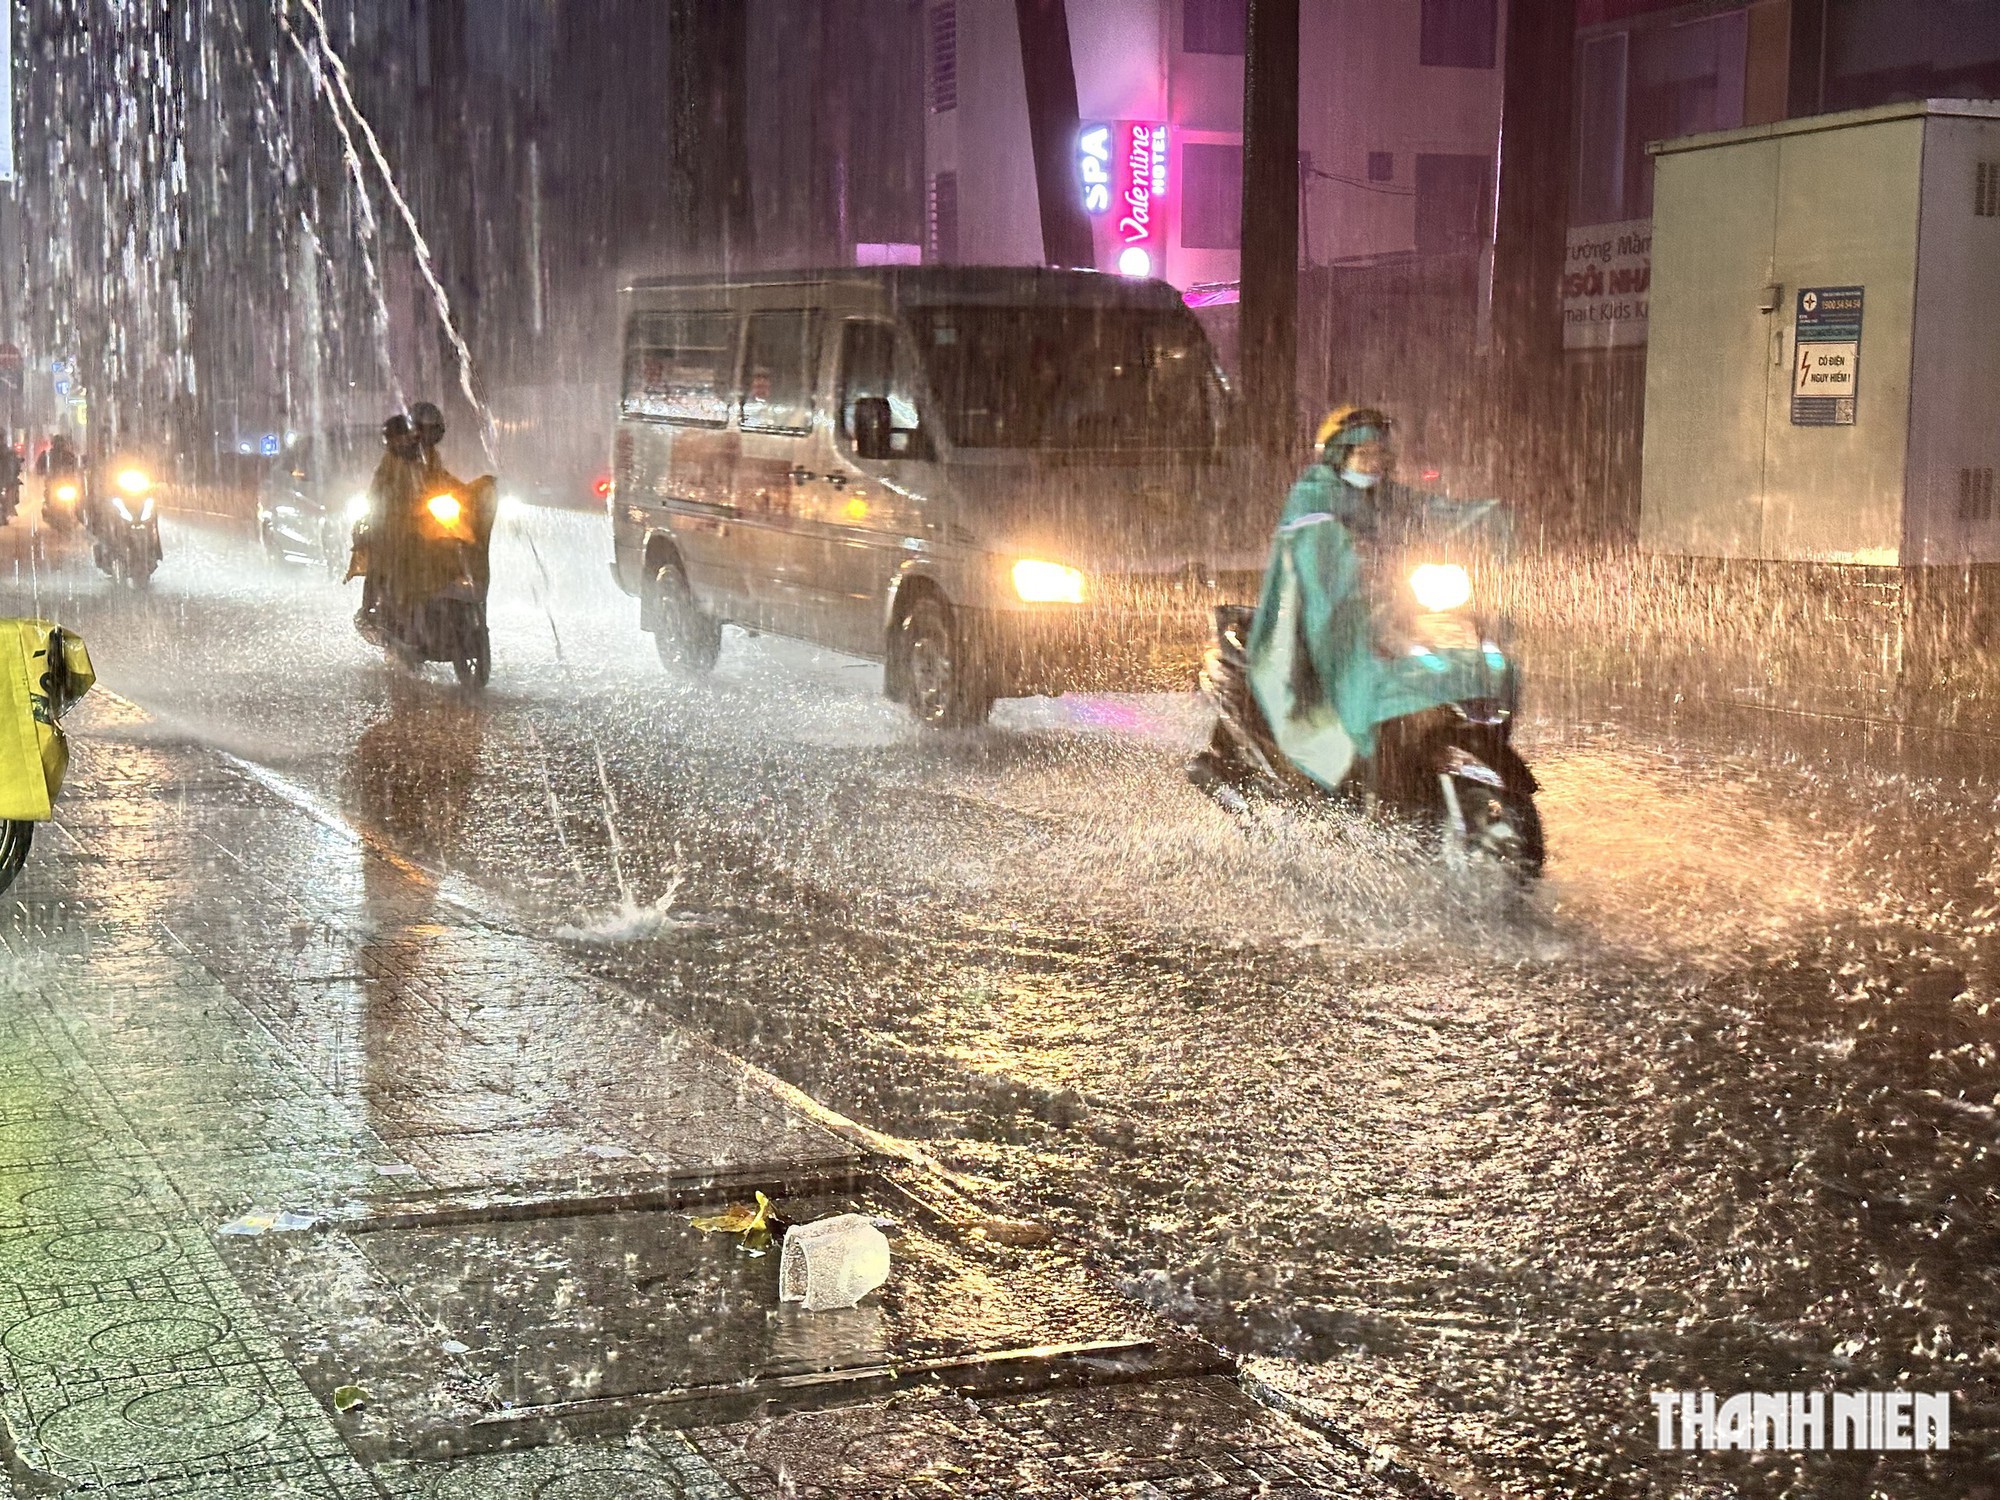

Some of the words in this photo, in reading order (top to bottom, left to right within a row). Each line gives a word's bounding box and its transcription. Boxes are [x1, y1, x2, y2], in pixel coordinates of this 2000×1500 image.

[1081, 127, 1109, 211] SPA
[1119, 125, 1151, 243] Valentine
[1151, 126, 1166, 195] HOTEL
[1811, 373, 1829, 383] NGUY
